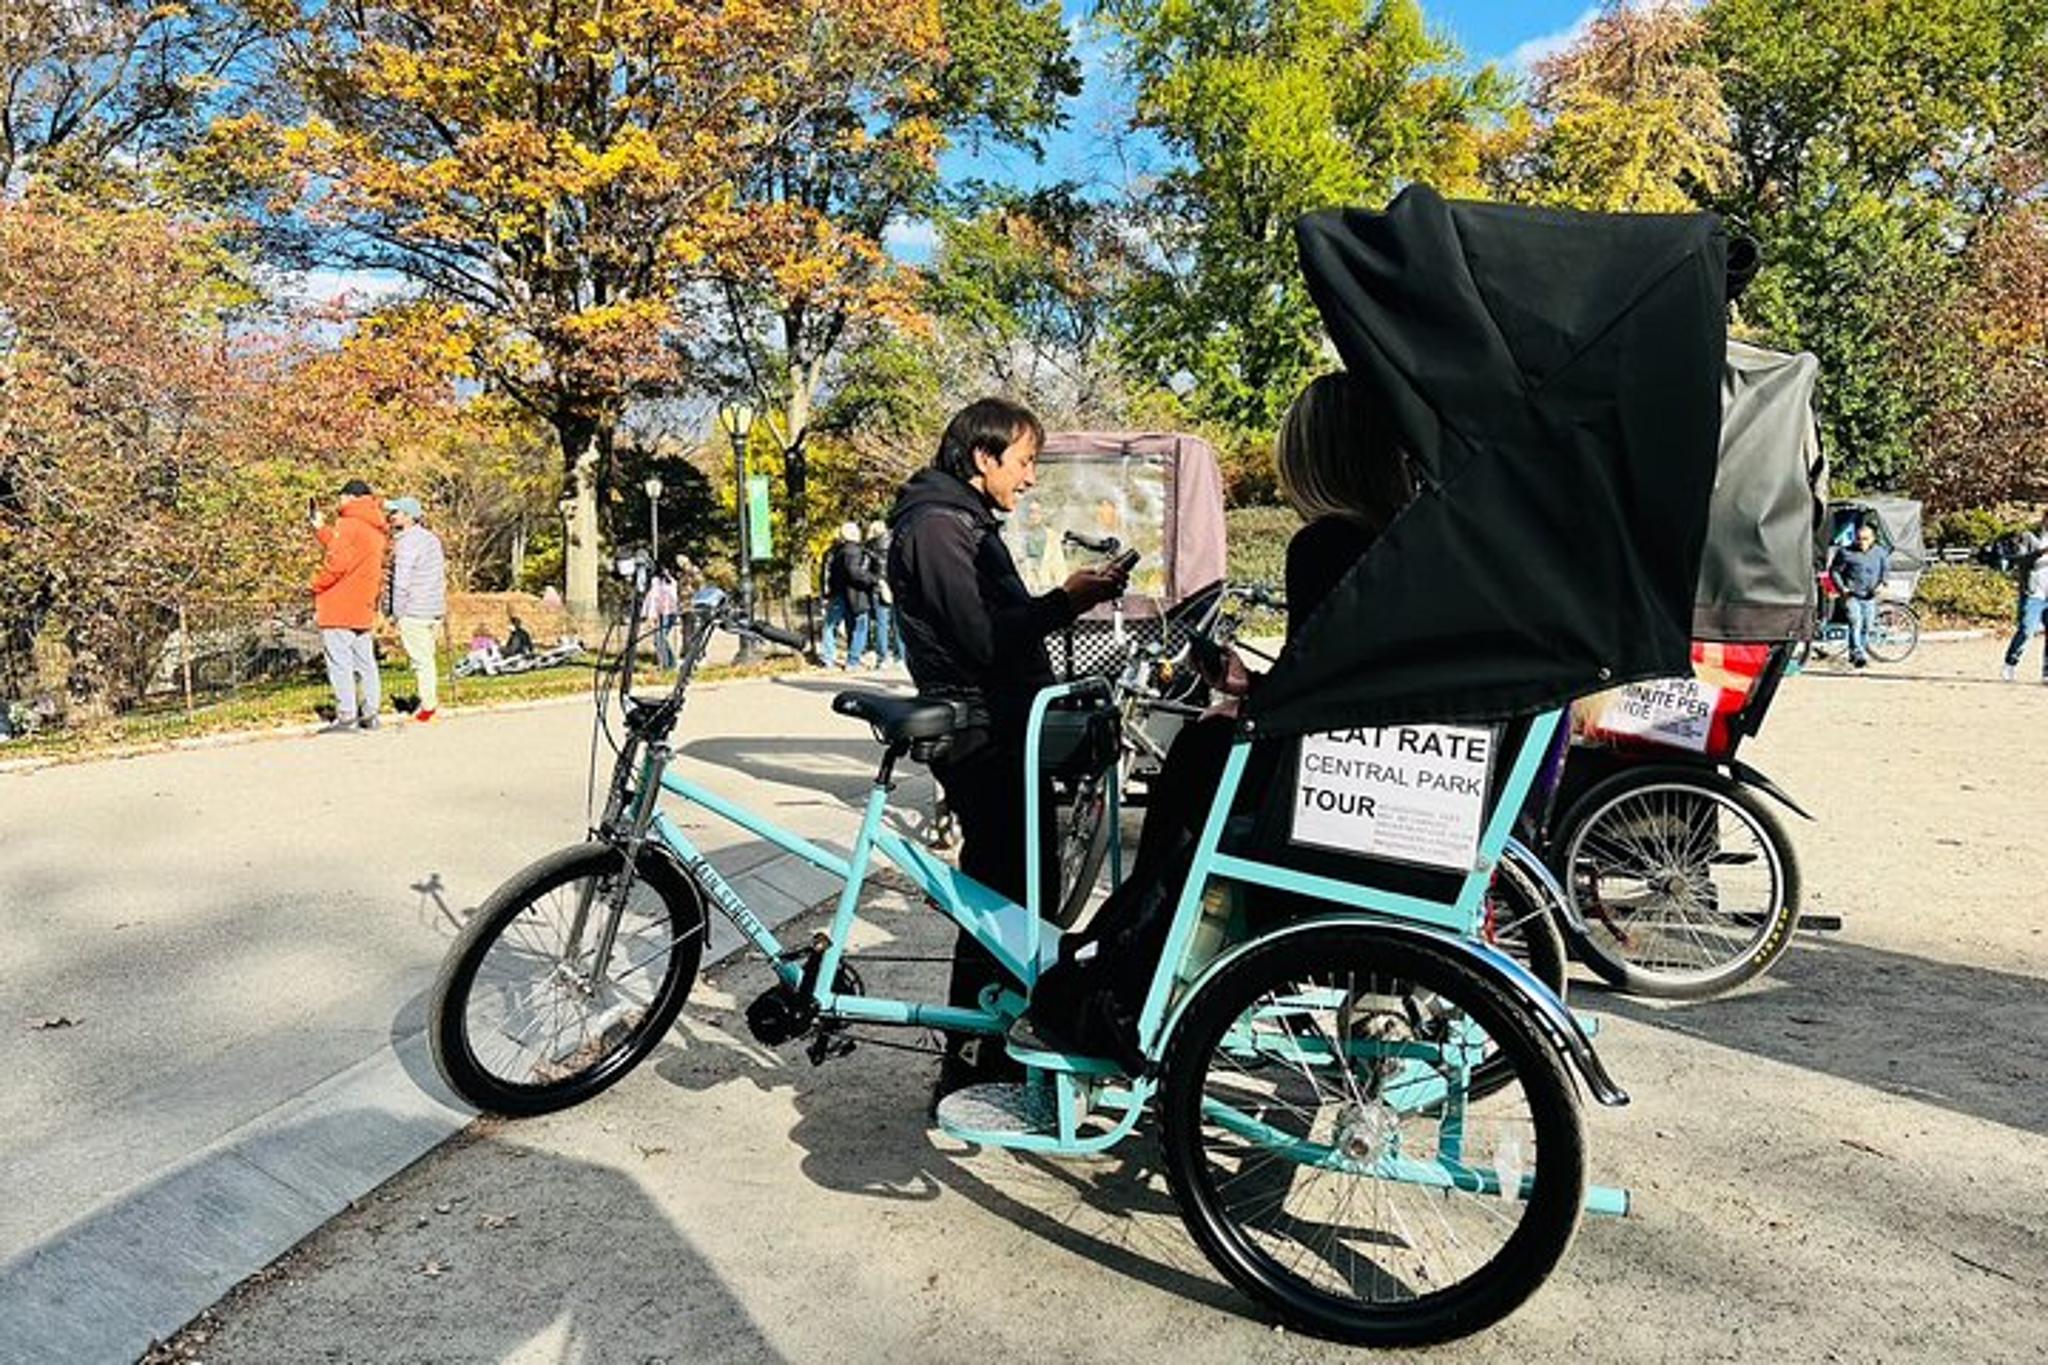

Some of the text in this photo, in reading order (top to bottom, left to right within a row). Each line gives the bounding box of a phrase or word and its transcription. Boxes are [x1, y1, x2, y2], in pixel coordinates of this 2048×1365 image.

[1678, 696, 1709, 718] PER
[1306, 727, 1487, 763] LAT RATE
[1304, 752, 1483, 797] CENTRAL PARK
[1302, 785, 1376, 818] TOUR
